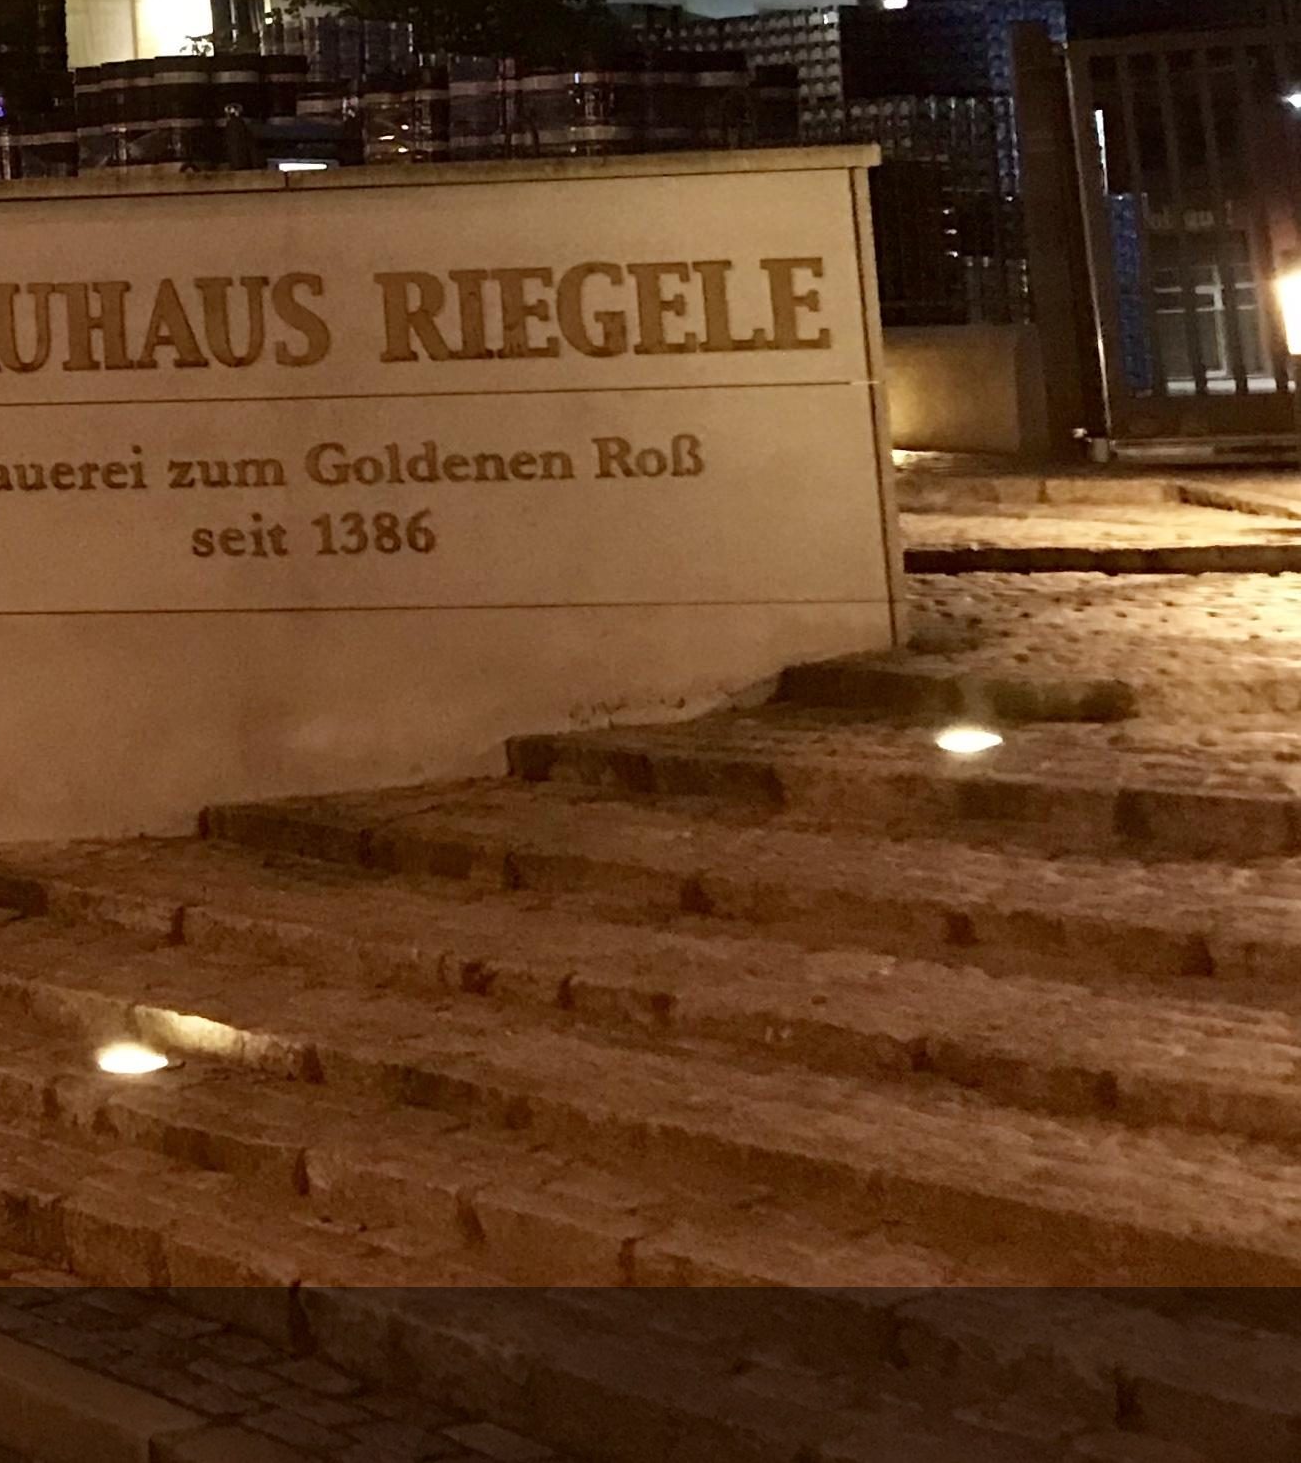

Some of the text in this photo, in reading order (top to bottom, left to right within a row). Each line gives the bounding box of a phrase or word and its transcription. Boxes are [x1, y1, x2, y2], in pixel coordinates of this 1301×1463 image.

[375, 256, 832, 362] RIEGELE
[166, 458, 287, 490] zum
[304, 438, 575, 488] Goldenen
[592, 434, 706, 481] Roß
[190, 509, 438, 558] seit 1386
